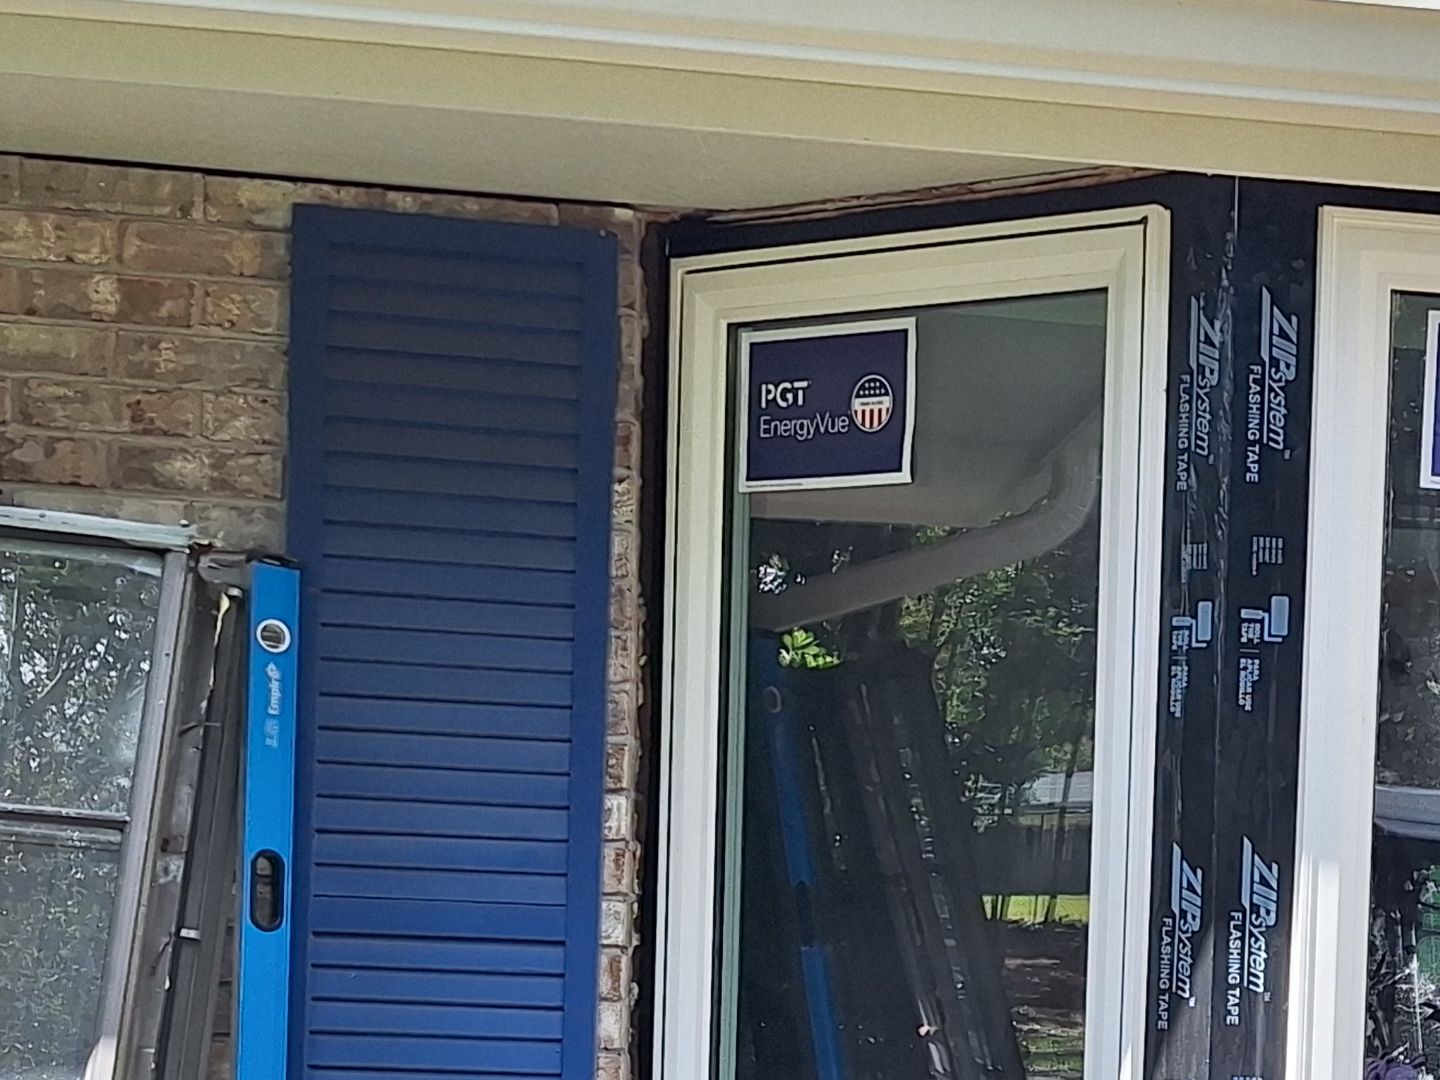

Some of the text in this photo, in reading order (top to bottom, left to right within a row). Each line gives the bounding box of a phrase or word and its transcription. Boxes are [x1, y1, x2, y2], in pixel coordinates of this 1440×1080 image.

[760, 380, 809, 409] PGT
[760, 412, 849, 441] EnergyVue
[1176, 374, 1191, 491] FLASHING TAPE
[1246, 364, 1261, 483] FLASHING TAPE
[1157, 917, 1173, 1031] FLASHING TAPE
[1226, 911, 1242, 1026] FLASHING TAPE
